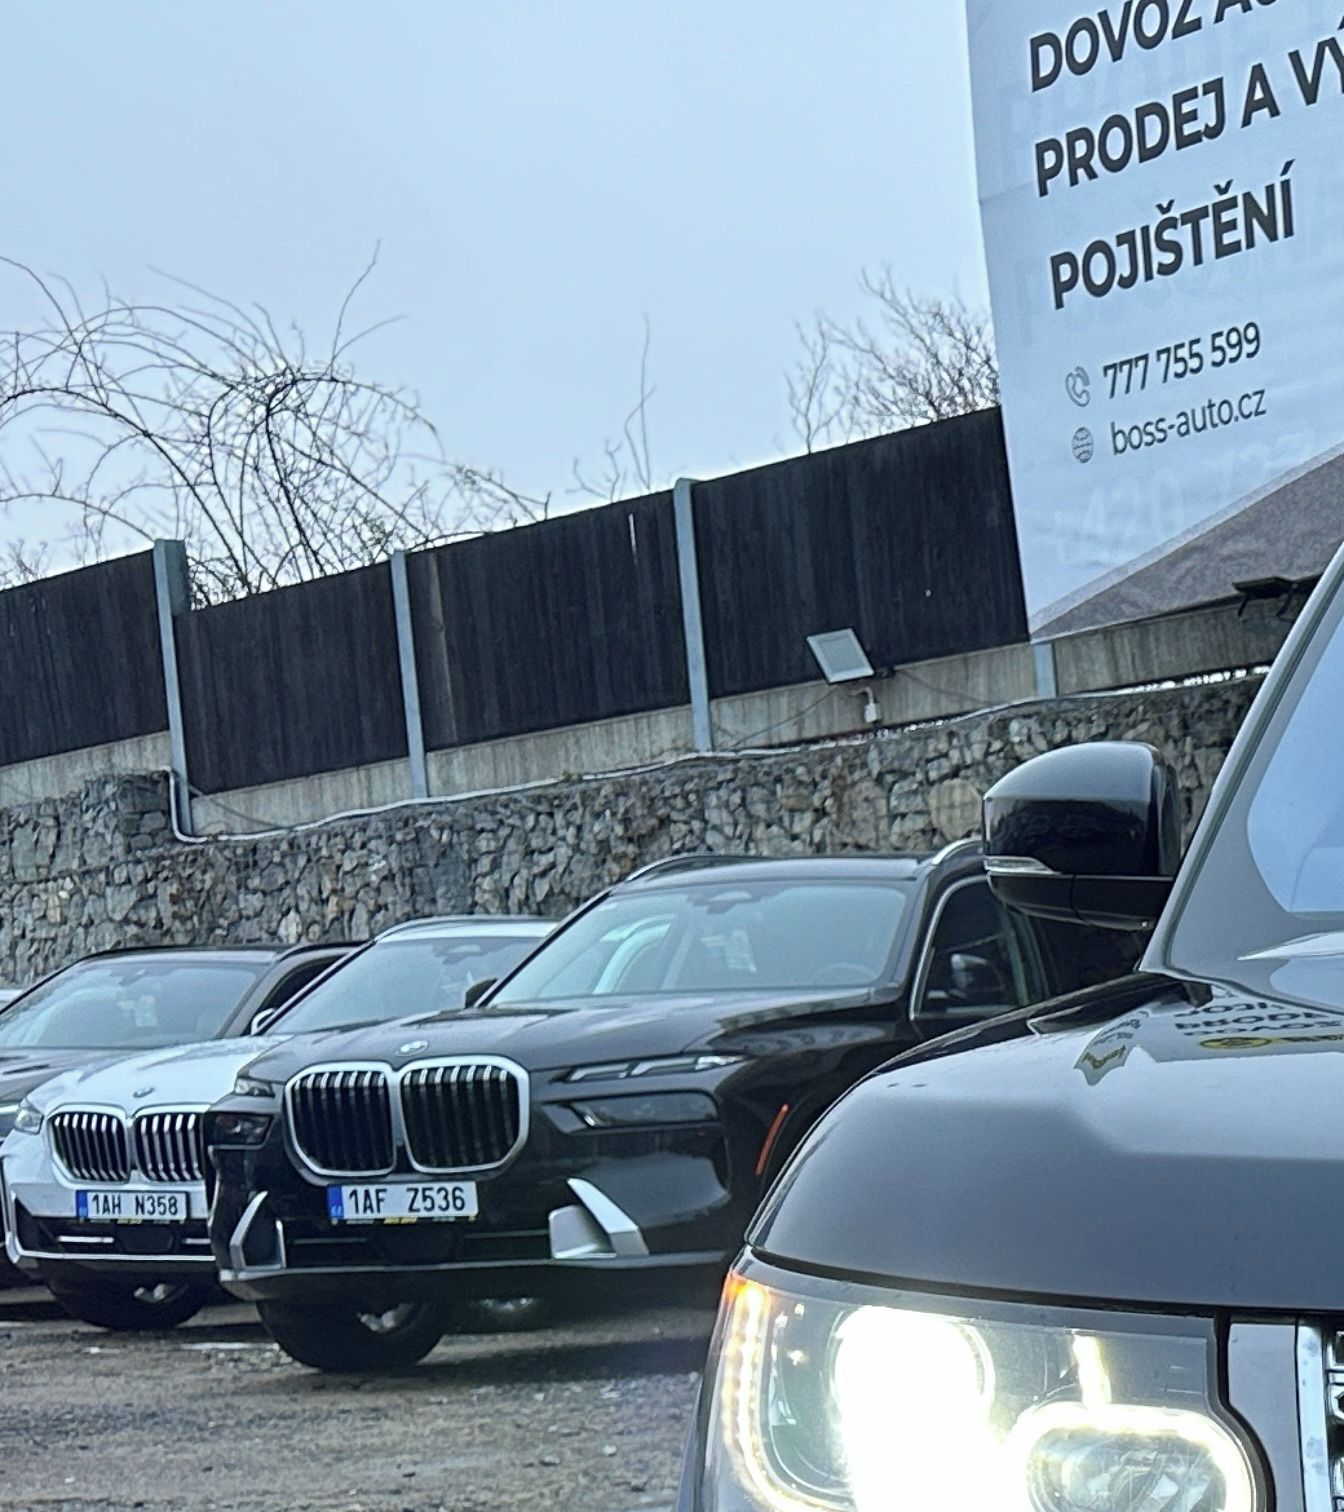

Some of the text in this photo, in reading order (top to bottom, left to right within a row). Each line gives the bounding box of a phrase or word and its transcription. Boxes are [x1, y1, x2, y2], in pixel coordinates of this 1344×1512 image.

[1029, 0, 1203, 93] DOVOZ
[1035, 76, 1226, 197] PRODEJ
[1240, 62, 1281, 129] A
[1050, 158, 1296, 311] POJIŠTĚNÍ
[1103, 321, 1262, 400] 777 755 599
[1109, 388, 1267, 456] boss-auto.cz
[92, 1194, 122, 1215] 1AH
[135, 1195, 179, 1216] N358
[348, 1188, 388, 1215] 1AF
[406, 1186, 466, 1213] Z536
